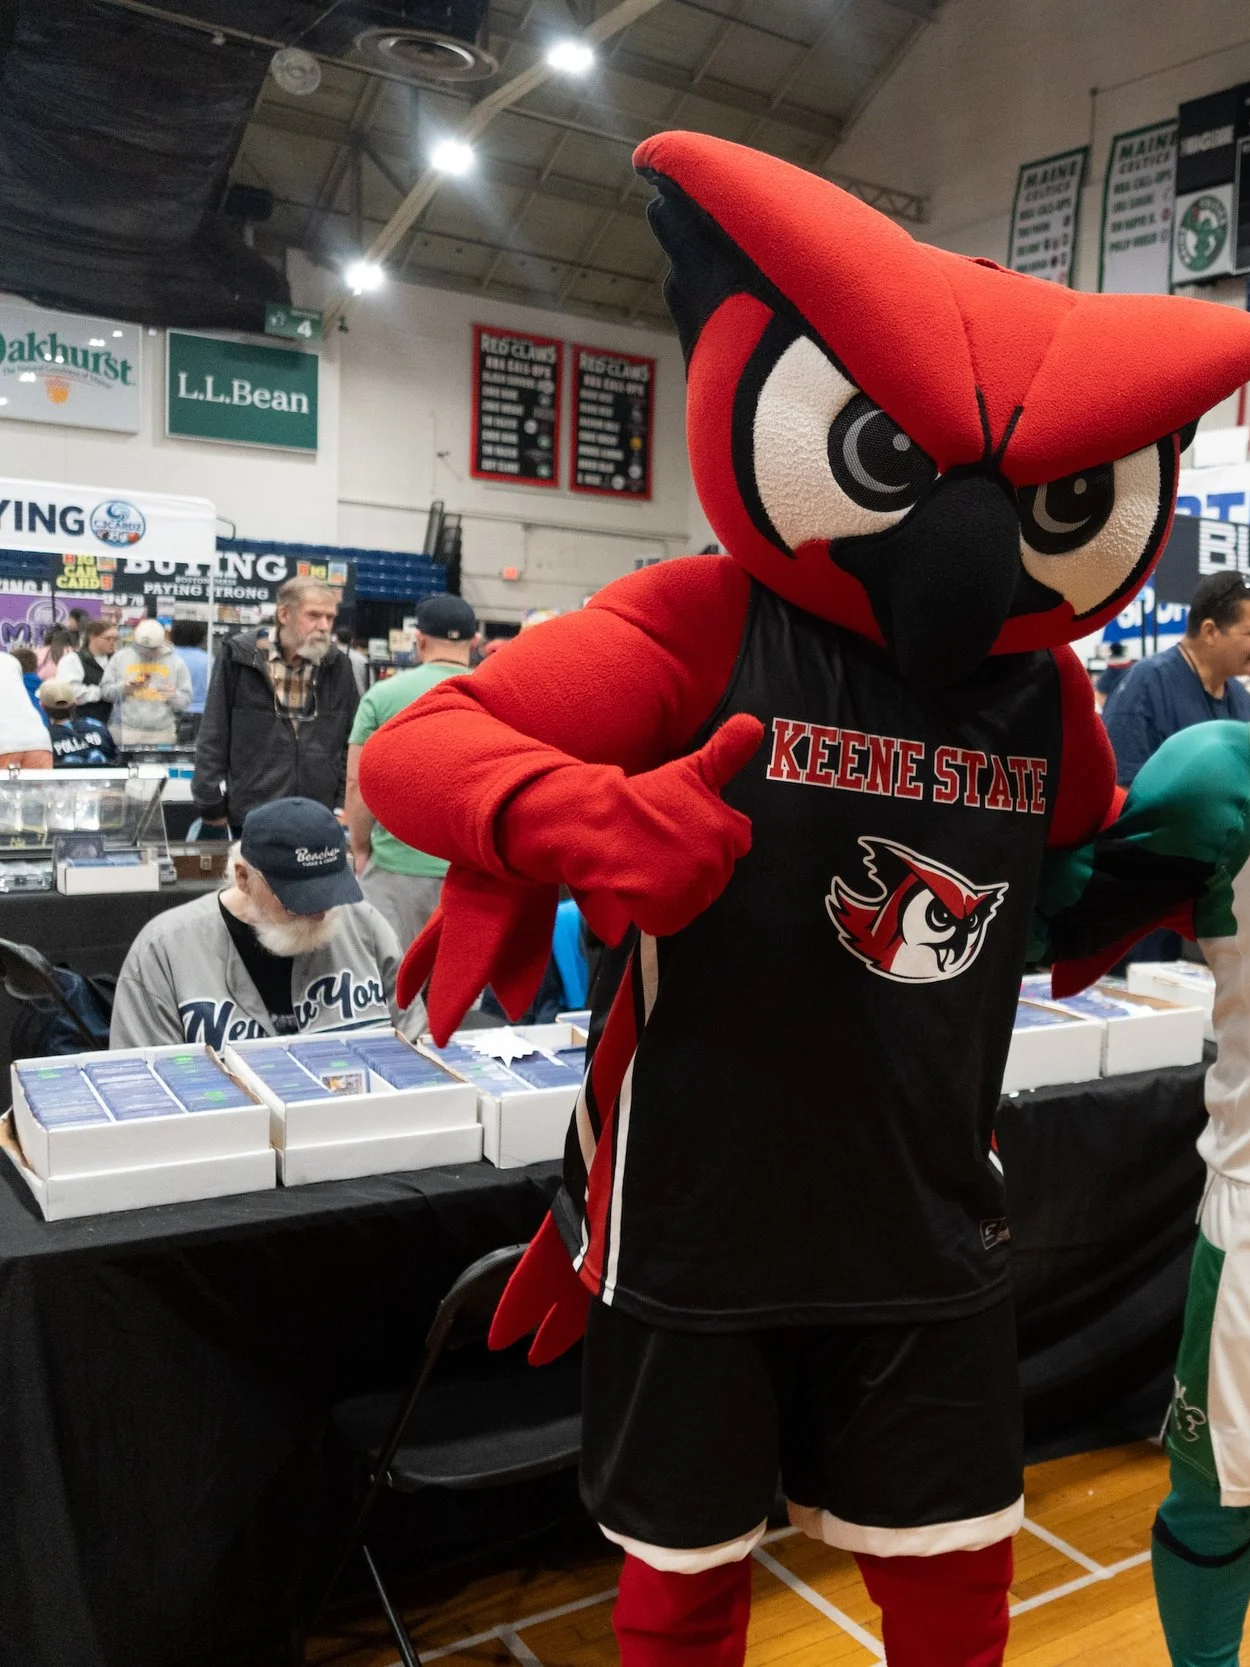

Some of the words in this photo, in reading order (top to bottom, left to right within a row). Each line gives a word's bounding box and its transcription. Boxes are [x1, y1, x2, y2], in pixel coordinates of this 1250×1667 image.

[297, 320, 312, 338] 4
[0, 331, 132, 386] akhurst
[177, 372, 310, 415] L.L.Bean
[144, 582, 202, 597] PAYING
[205, 585, 269, 600] STRONG
[766, 717, 925, 801] KEENE
[933, 745, 1048, 815] STATE
